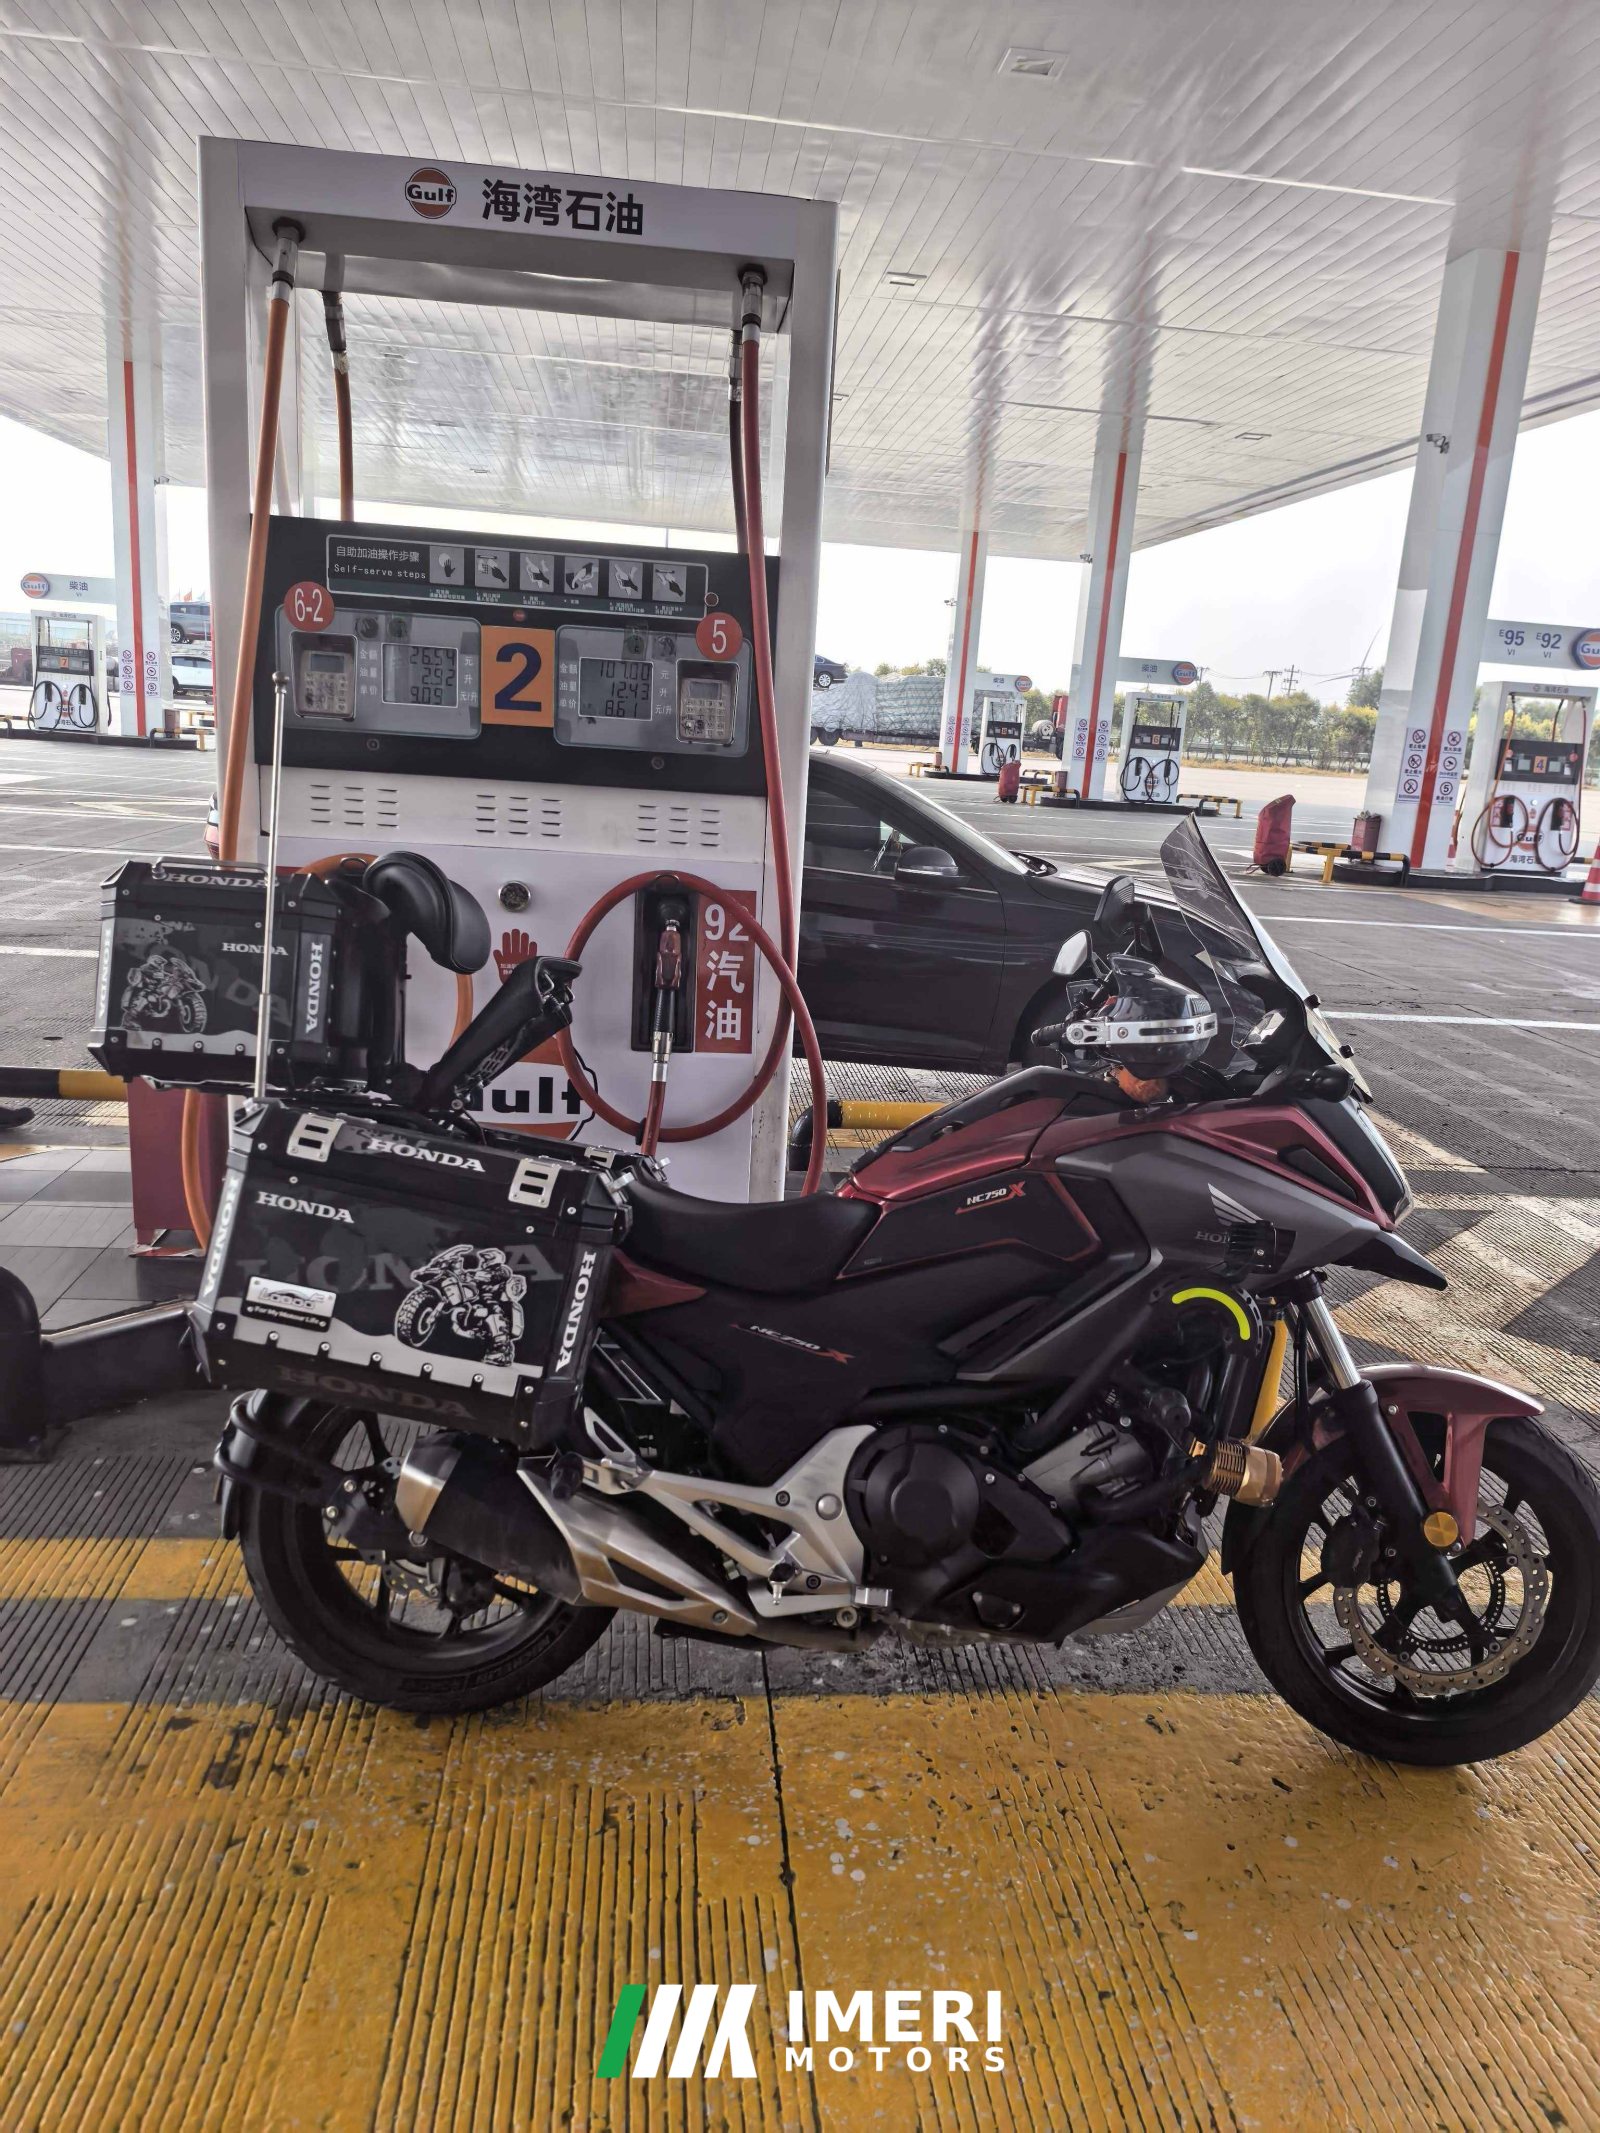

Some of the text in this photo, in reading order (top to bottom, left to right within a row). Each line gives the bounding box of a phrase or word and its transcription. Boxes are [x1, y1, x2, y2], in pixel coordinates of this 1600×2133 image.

[407, 184, 455, 203] Gulf
[481, 178, 644, 236] 海湾石油
[336, 546, 420, 563] 自助加油操作步骤
[334, 563, 426, 580] Self-serve steps
[22, 582, 46, 590] Gulf
[69, 580, 89, 591] 柴油
[294, 588, 323, 622] 6-2
[711, 619, 727, 654] 5
[1499, 629, 1525, 646] E95
[1536, 632, 1562, 649] E92
[410, 645, 455, 666] 26.54
[1581, 643, 1600, 655] Gu
[463, 656, 473, 666] 元
[422, 667, 456, 687] 2.92
[463, 675, 473, 685] 升
[494, 642, 542, 712] 2
[600, 661, 650, 681] 107.00
[660, 671, 670, 680] 元
[410, 686, 443, 705] 9.09
[611, 681, 650, 700] 12.43
[605, 700, 637, 718] 8.61
[1537, 760, 1544, 770] 4
[1443, 784, 1450, 793] 5
[1516, 833, 1543, 842] Guf
[1510, 854, 1538, 864] 海湾石
[163, 872, 280, 888] HONDA
[221, 941, 289, 956] HONA
[305, 941, 323, 1034] HONDA
[705, 949, 746, 1041] 汽油
[365, 1138, 486, 1173] HONDA
[255, 1190, 355, 1224] HONDA
[202, 1177, 240, 1298] HONDA
[236, 1243, 563, 1295] ONA
[555, 1250, 597, 1373] HONDA
